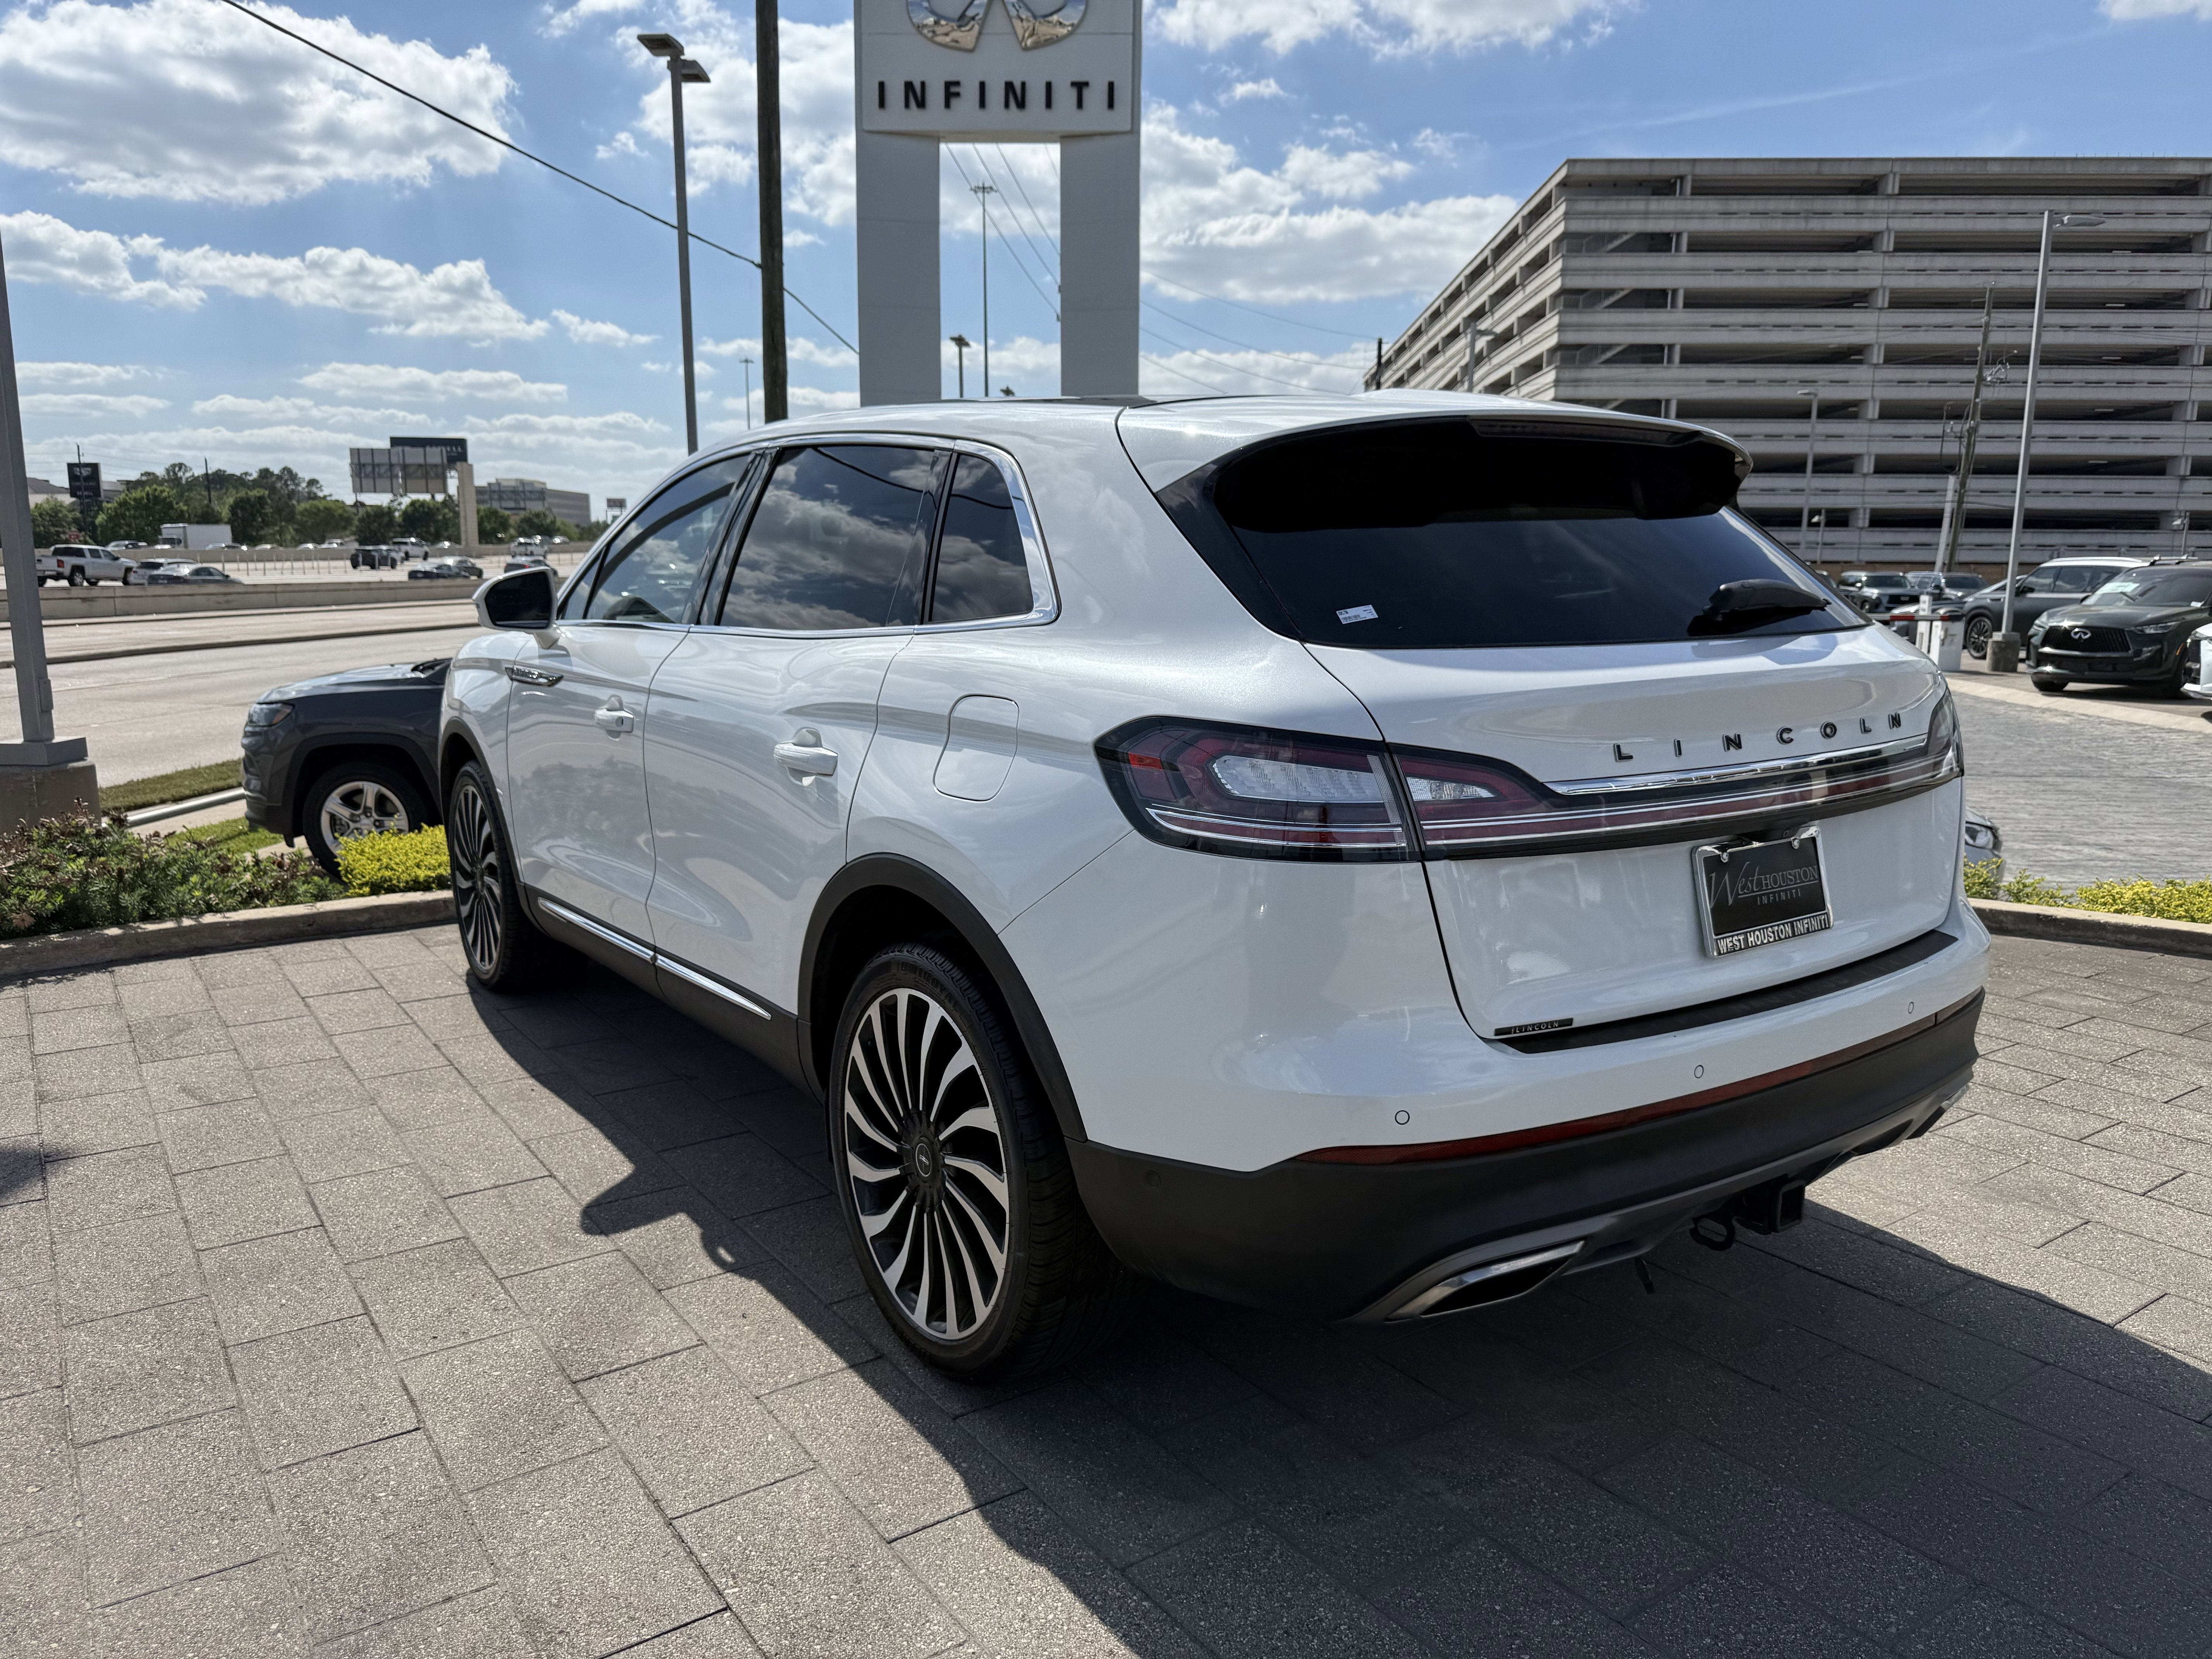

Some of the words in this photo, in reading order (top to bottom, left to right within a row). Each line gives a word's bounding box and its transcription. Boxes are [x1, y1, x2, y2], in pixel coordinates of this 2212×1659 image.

[878, 81, 1115, 110] INFINITI
[1613, 712, 1901, 762] LINCOLN
[1757, 888, 1801, 905] INFINITI
[1717, 934, 1745, 954] WEST
[1747, 923, 1791, 947] HOUSTON
[1793, 914, 1829, 934] INFINITI
[1516, 1021, 1559, 1033] LINCOLN
